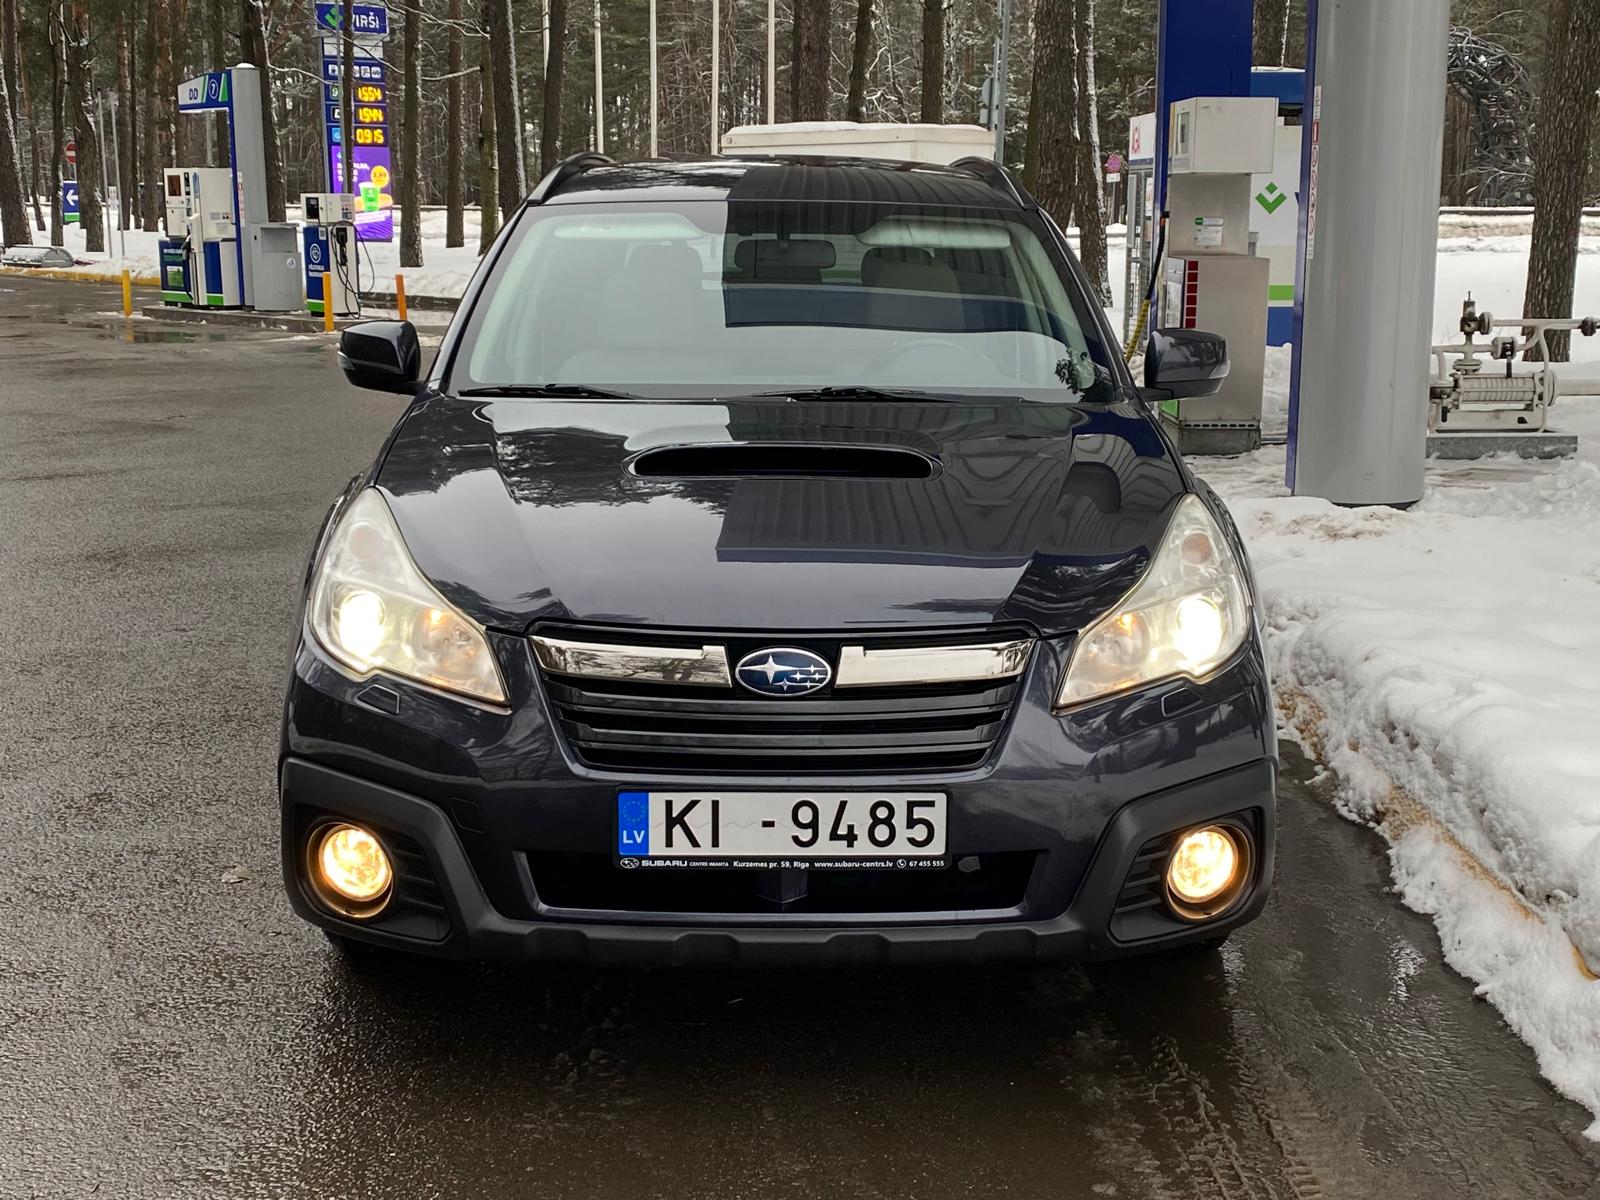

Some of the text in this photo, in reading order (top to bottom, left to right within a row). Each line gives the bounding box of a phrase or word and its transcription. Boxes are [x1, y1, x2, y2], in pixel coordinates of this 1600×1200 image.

[189, 88, 199, 100] DD
[665, 799, 720, 848] KI
[622, 830, 645, 844] LV
